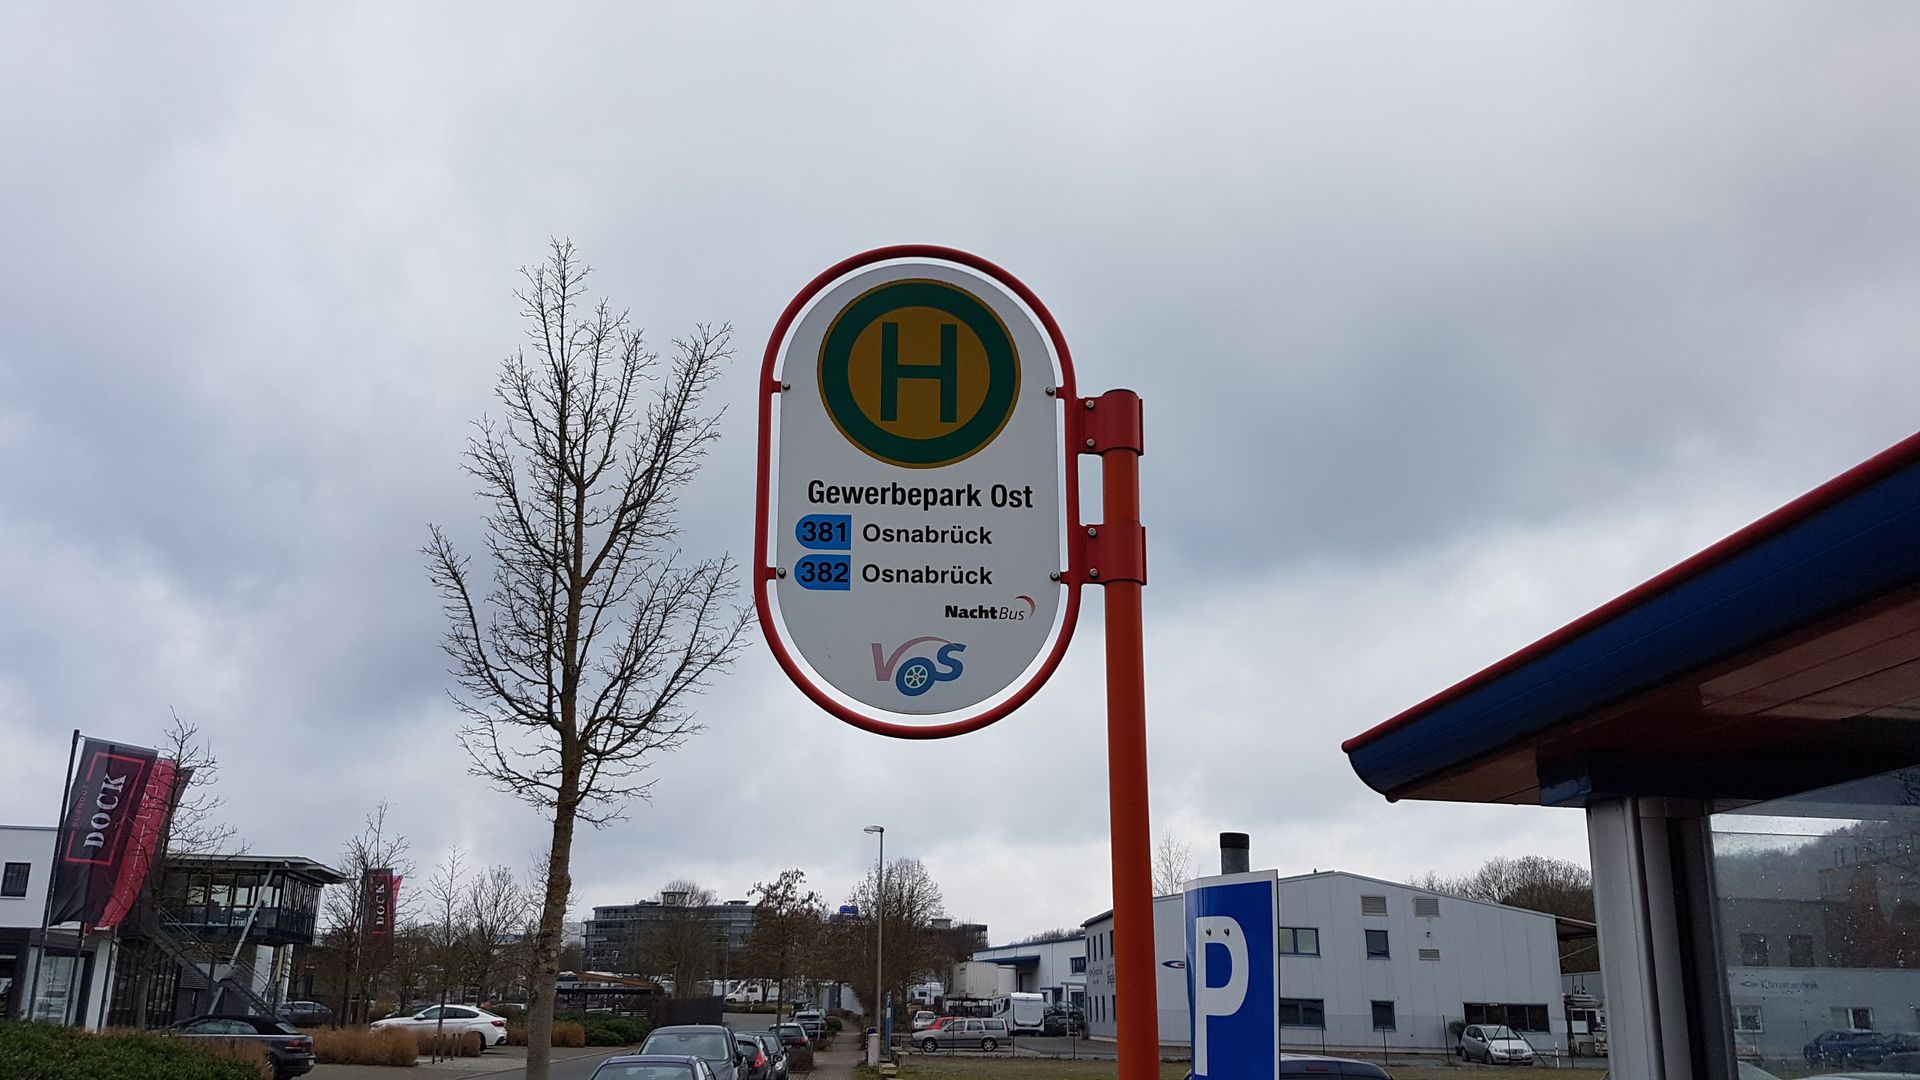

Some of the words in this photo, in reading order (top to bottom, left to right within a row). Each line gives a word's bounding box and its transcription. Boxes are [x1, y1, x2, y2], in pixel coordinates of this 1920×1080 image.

[880, 322, 958, 424] H
[807, 480, 982, 511] Gewerbepark
[990, 484, 1034, 508] Ost
[801, 521, 847, 543] 381
[862, 523, 993, 545] Osnabrück
[800, 562, 849, 583] 382
[862, 563, 993, 585] Osnabrück
[871, 636, 967, 696] VOS
[84, 773, 127, 849] DOCK
[375, 883, 386, 925] DOCK
[1194, 915, 1250, 1076] P
